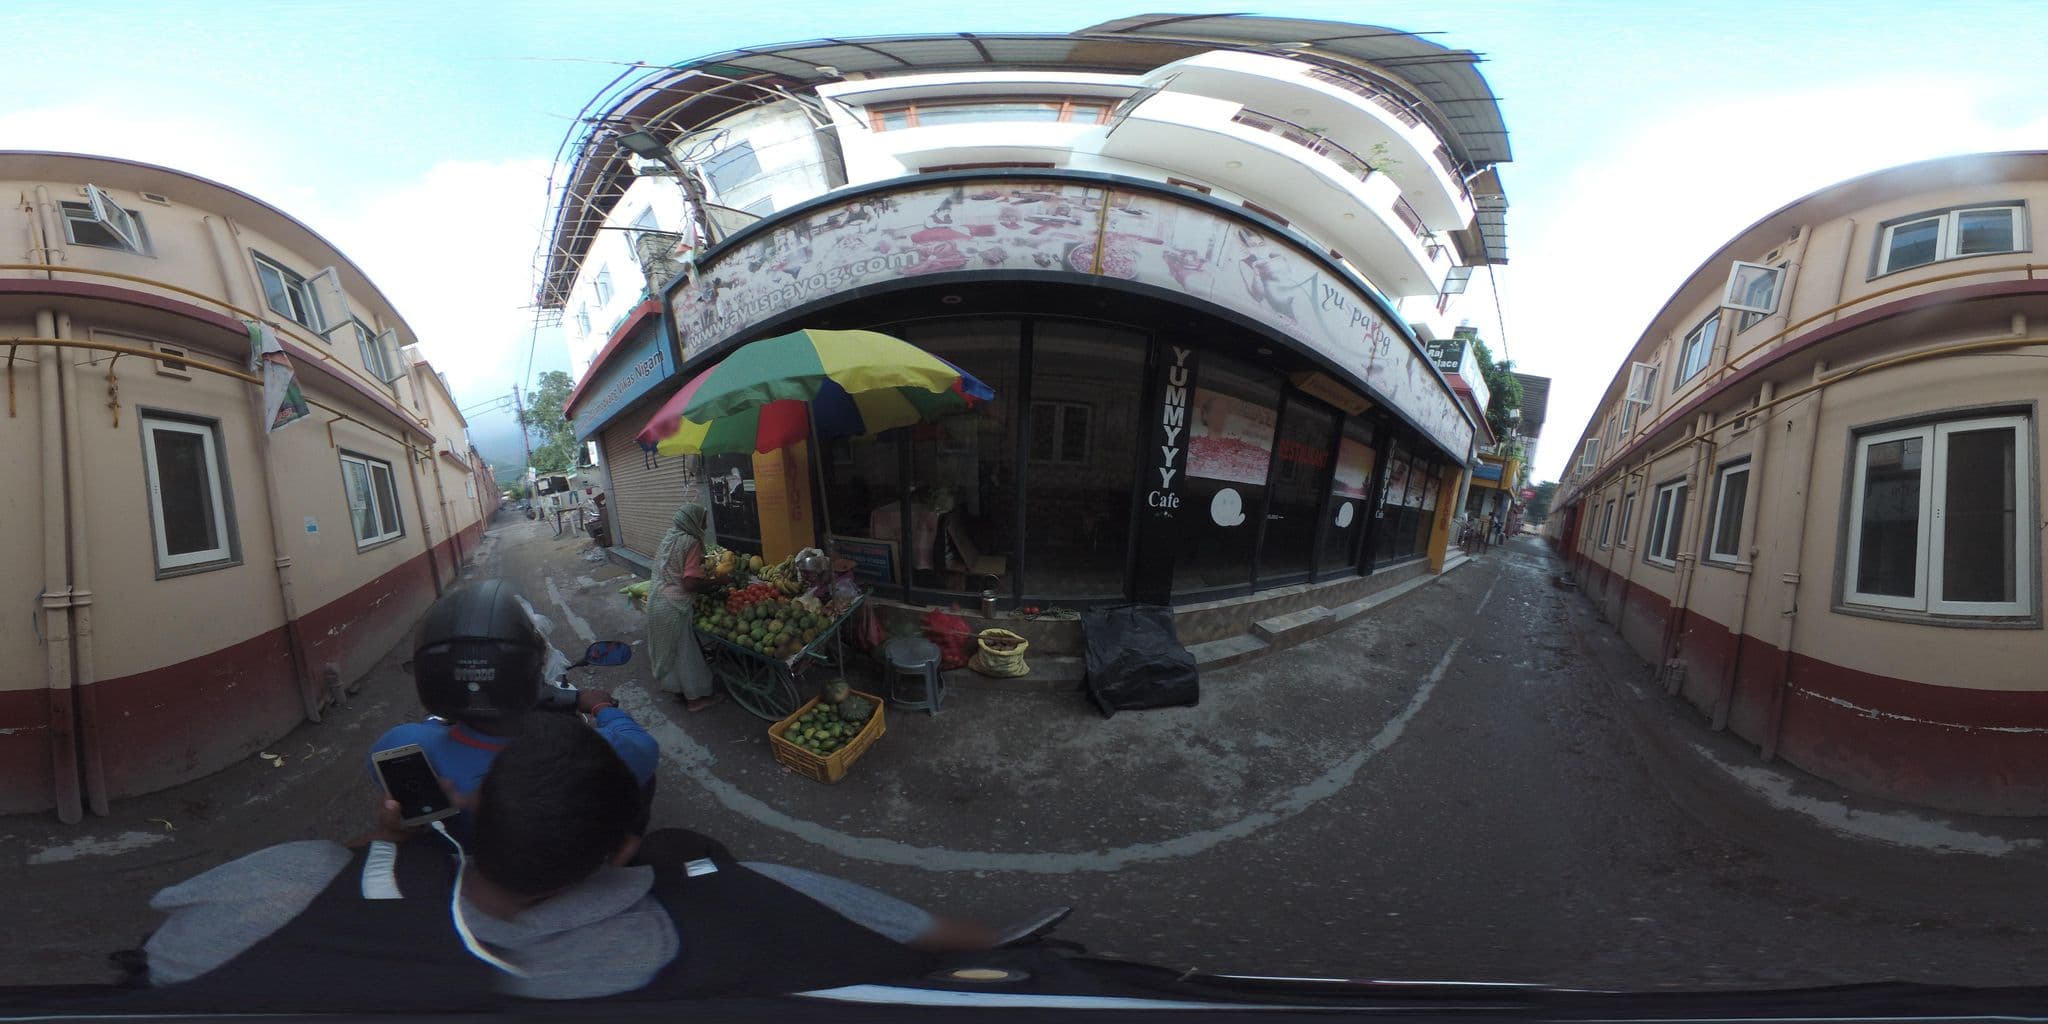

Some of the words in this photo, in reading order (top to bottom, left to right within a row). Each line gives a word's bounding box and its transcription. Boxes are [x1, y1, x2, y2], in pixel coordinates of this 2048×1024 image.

[634, 350, 664, 377] Nigam
[1434, 360, 1458, 368] alace
[1159, 346, 1191, 489] YUMMYYY
[1149, 490, 1180, 508] Cafe
